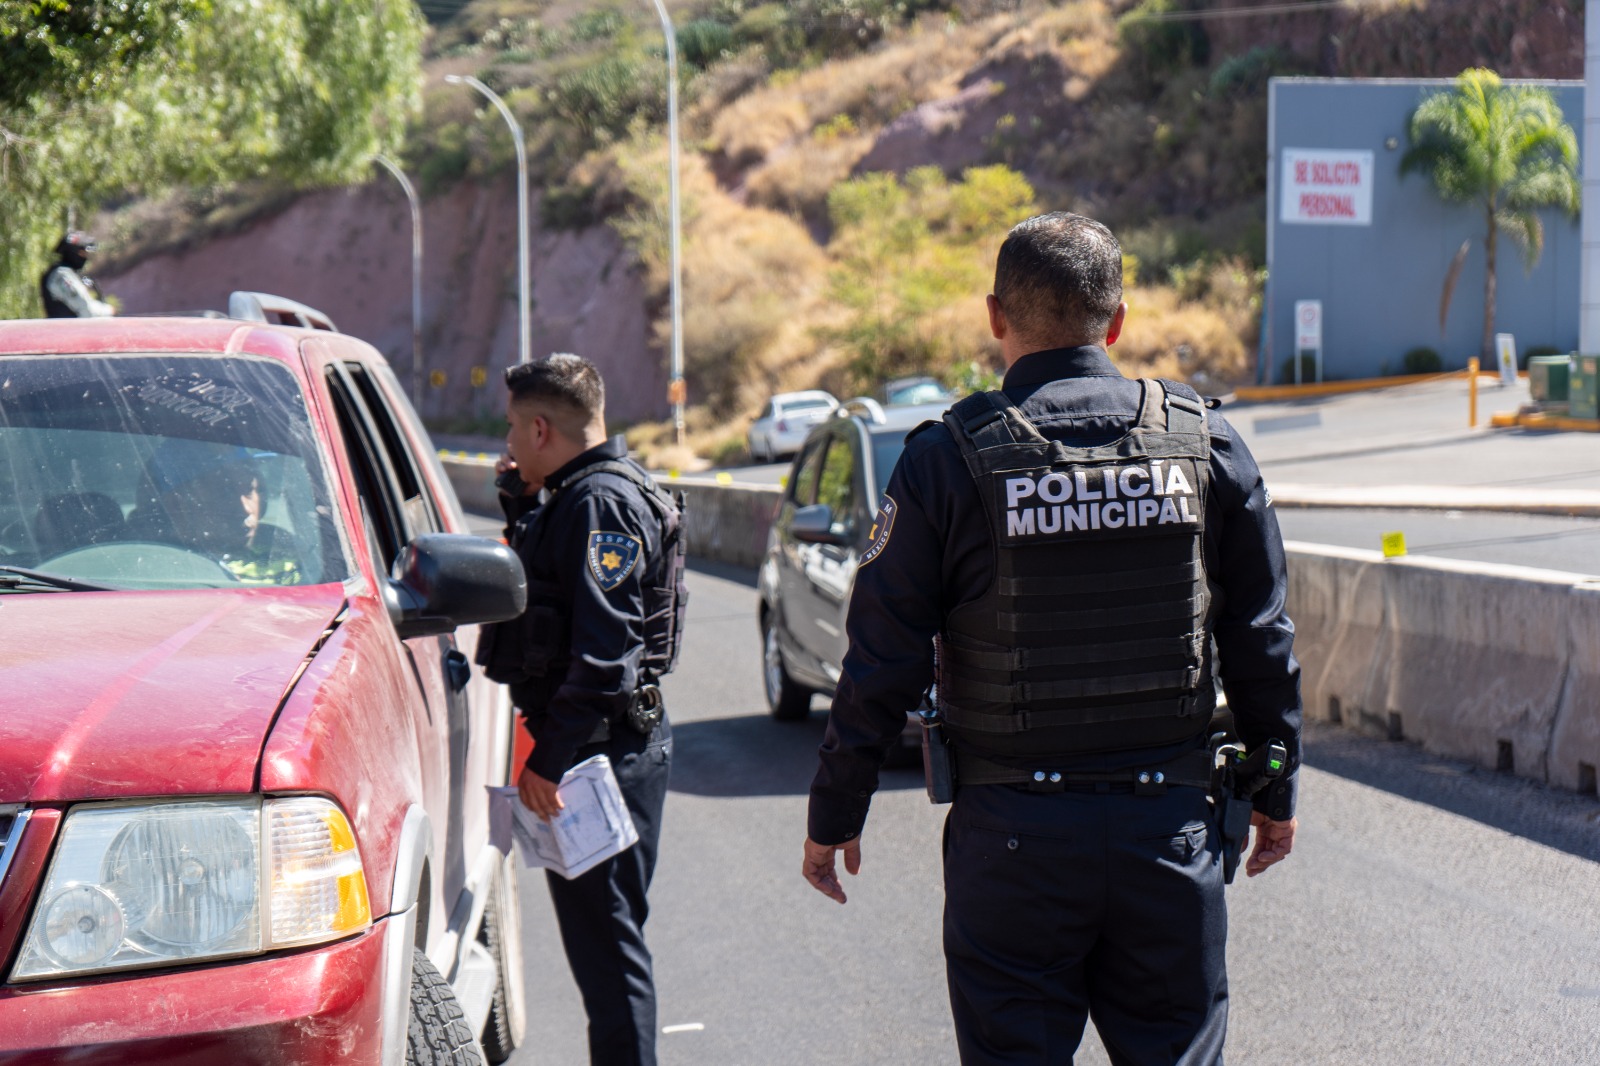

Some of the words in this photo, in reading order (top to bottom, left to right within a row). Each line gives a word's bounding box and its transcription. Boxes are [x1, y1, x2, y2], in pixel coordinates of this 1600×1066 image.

[1312, 160, 1360, 185] SOLICITA
[1300, 193, 1356, 218] PERSONAL
[1005, 459, 1193, 508] POLICÍA
[1007, 496, 1198, 537] MUNICIPAL
